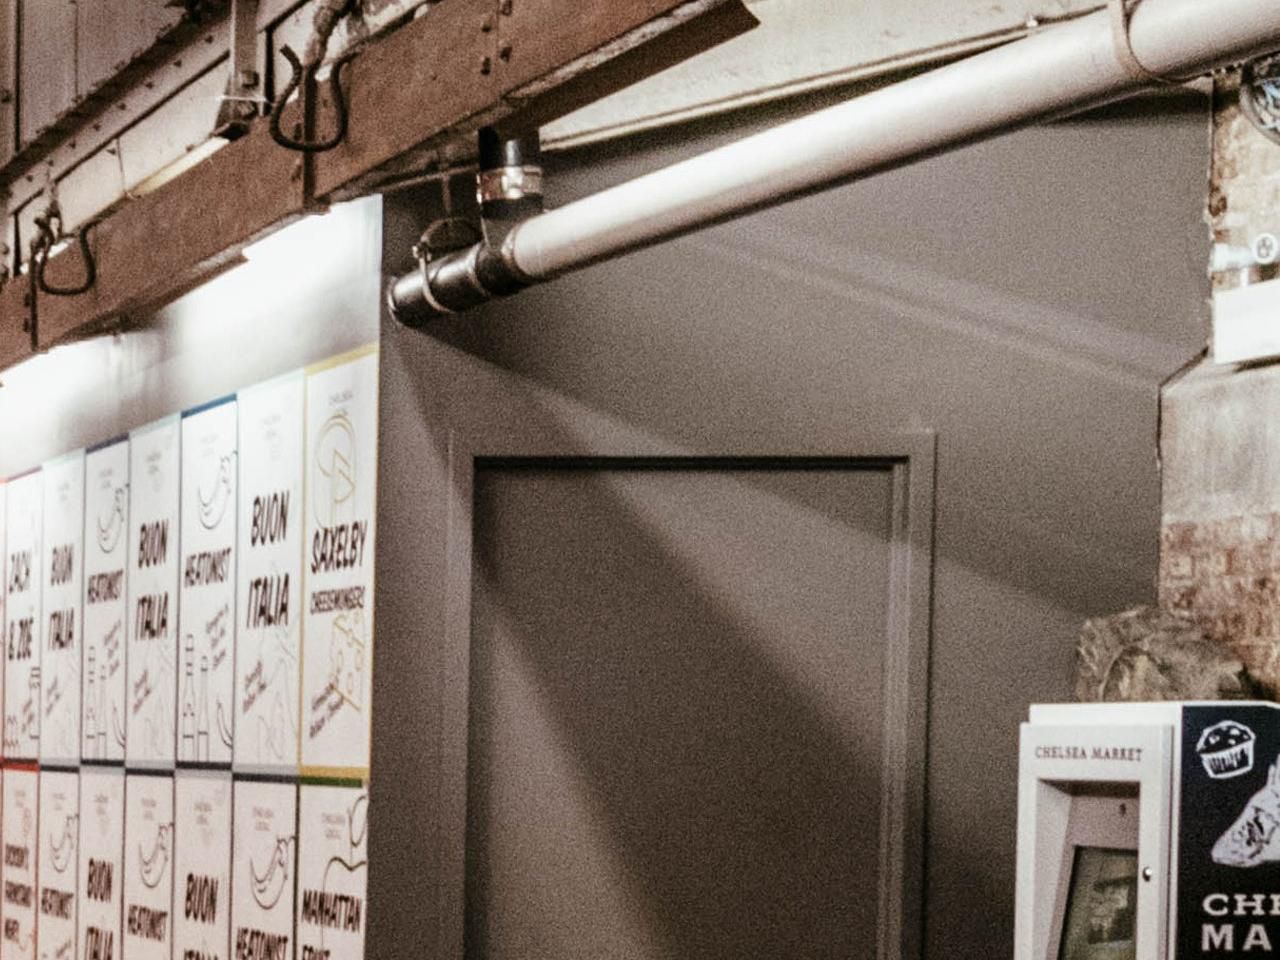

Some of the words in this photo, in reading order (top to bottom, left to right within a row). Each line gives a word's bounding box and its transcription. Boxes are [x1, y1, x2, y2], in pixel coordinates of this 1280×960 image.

[250, 489, 290, 548] BUON
[51, 543, 75, 587] BUON
[138, 518, 170, 569] BUON
[311, 519, 369, 575] SAXELBY
[87, 568, 124, 605] HEATONIST
[184, 546, 231, 589] HEATONIST
[134, 590, 169, 641] ITALIA
[247, 572, 290, 629] ITALIA
[47, 606, 75, 652] ITALIA
[1034, 745, 1088, 761] CHELSEA
[1090, 747, 1144, 763] MARKET
[87, 856, 114, 903] BUON
[184, 871, 220, 926] BUON
[127, 902, 169, 942] HEATONIST
[300, 887, 363, 935] MANHATTAN
